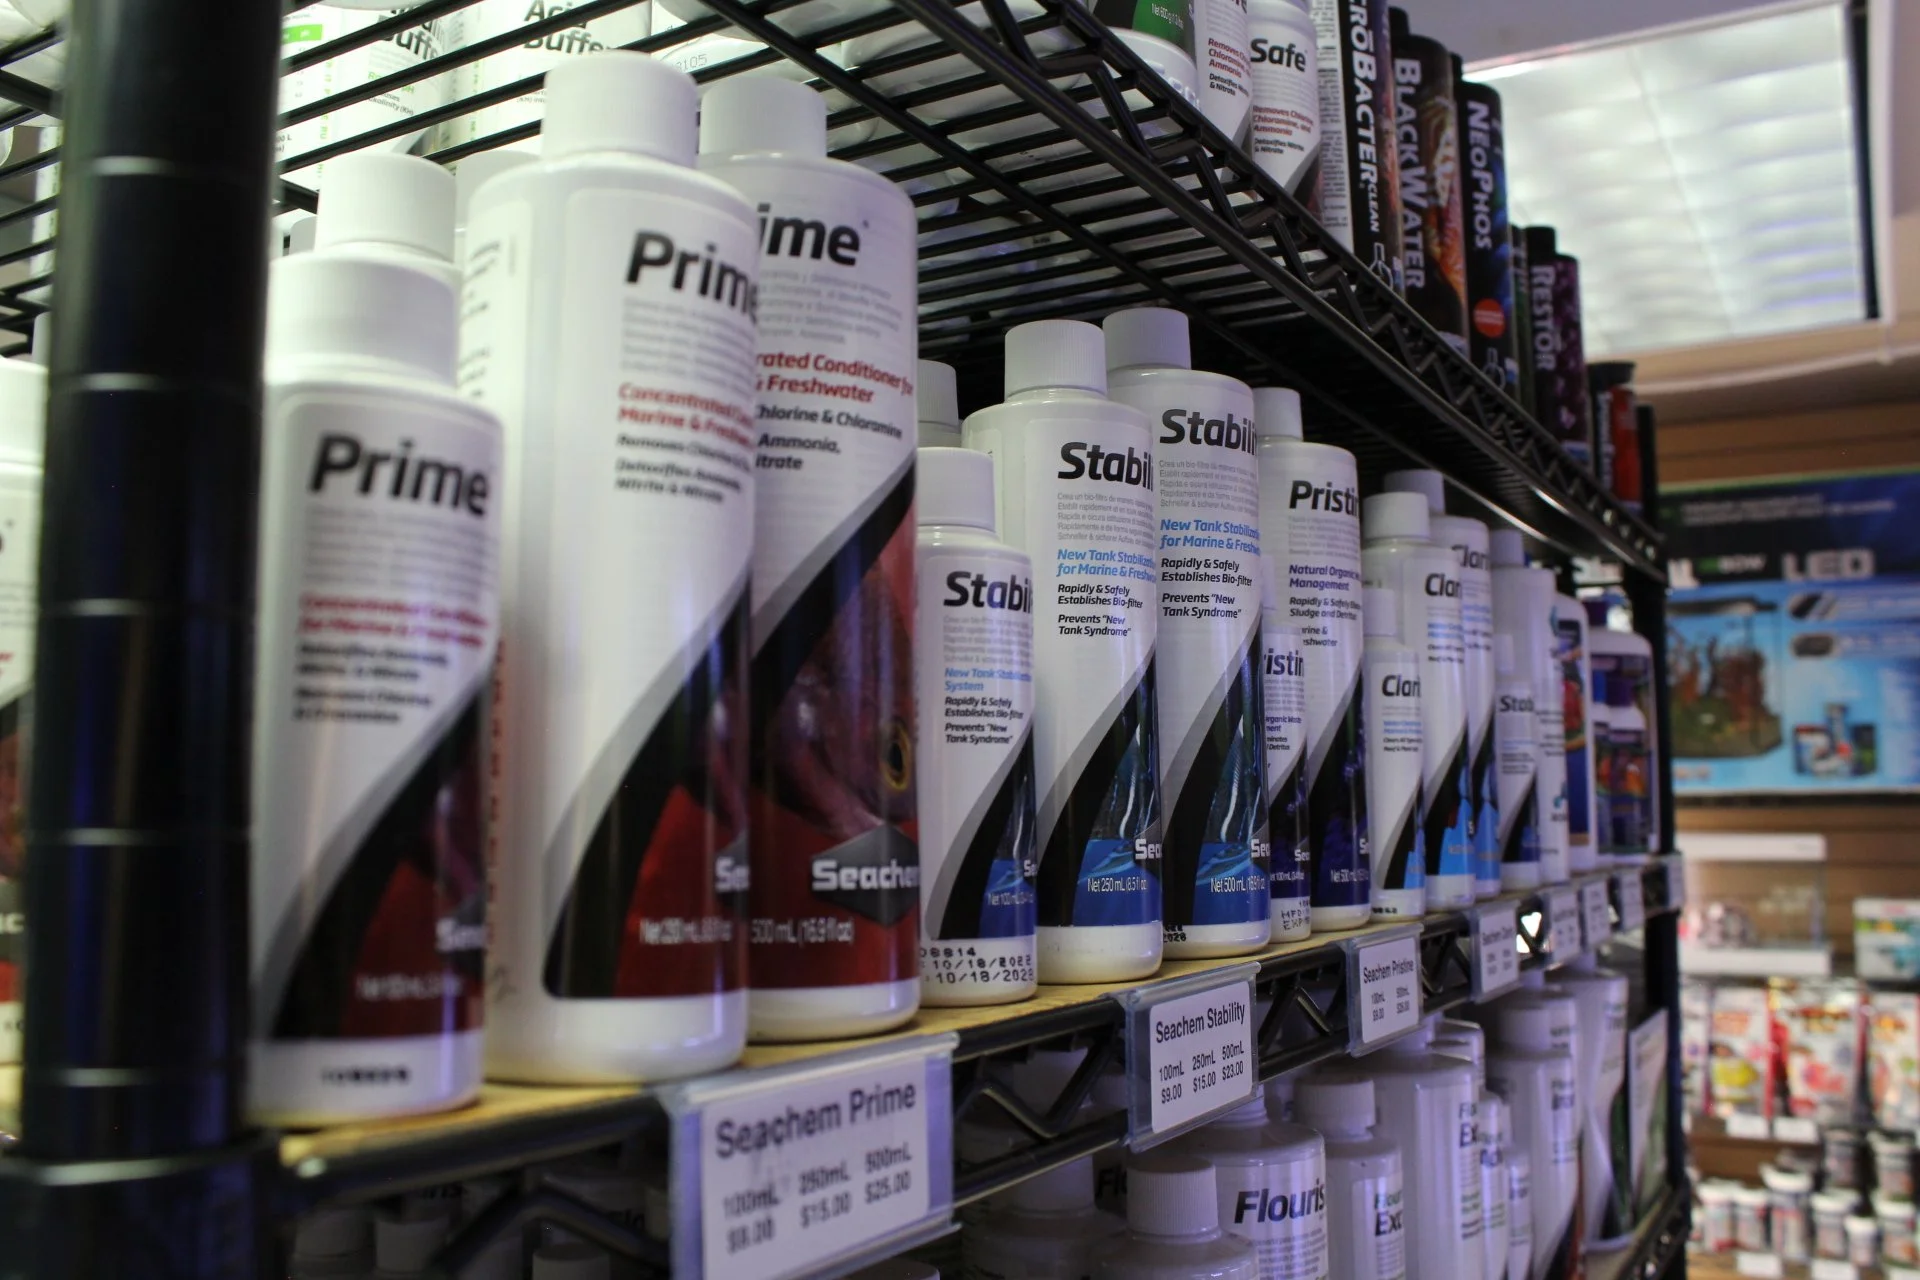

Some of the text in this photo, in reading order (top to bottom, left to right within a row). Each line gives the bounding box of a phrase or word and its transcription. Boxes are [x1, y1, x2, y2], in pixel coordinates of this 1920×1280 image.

[1250, 38, 1308, 73] Safe
[1466, 100, 1497, 250] NEOPHOS
[1369, 180, 1384, 233] CLEAN
[625, 229, 757, 324] Prim
[813, 354, 905, 390] Conditioner
[767, 373, 875, 403] Freshwater
[822, 407, 833, 425] &
[757, 432, 842, 454] Ammonia,
[309, 431, 489, 518] Prime
[1289, 479, 1360, 519] Pristi
[1159, 518, 1222, 532] New Tank
[1159, 533, 1234, 550] for Marine &
[1057, 549, 1117, 561] New Tank
[1056, 562, 1128, 577] for Marine &
[1161, 557, 1240, 573] Rapidly & Safely
[1289, 563, 1328, 576] Natural
[1161, 571, 1253, 587] Establishes Bio-filter
[1289, 577, 1350, 591] Management
[943, 570, 1033, 614] Stabil
[1057, 584, 1131, 598] Rapidly & Safely
[1161, 592, 1235, 605] Prevents "New
[1057, 595, 1144, 609] Establishes Bio-filter
[1289, 596, 1322, 608] Rapidly
[1058, 615, 1126, 625] Prevents "New
[1162, 606, 1242, 619] Tank Syndrome"
[1289, 607, 1320, 619] Sludge
[1321, 608, 1335, 618] and
[1058, 625, 1132, 637] Tank Syndrome"
[944, 680, 985, 693] System
[945, 696, 980, 707] Rapidly
[981, 697, 987, 706] &
[945, 707, 995, 718] Establishes
[944, 723, 985, 733] Prevents
[945, 734, 968, 744] Tank
[1087, 878, 1101, 892] Net
[1101, 877, 1114, 892] 250
[1114, 877, 1125, 892] mL
[1210, 877, 1246, 893] Net 500 mL
[1363, 957, 1414, 984] Seachem Pristine
[1156, 1002, 1246, 1044] Seachem Stability
[1158, 1040, 1245, 1082] 100mL 250mL 500mL
[1161, 1060, 1244, 1104] $9.00 $15.00 $23.00
[715, 1082, 916, 1160] Seachem Prime
[864, 1170, 911, 1204] $25.00
